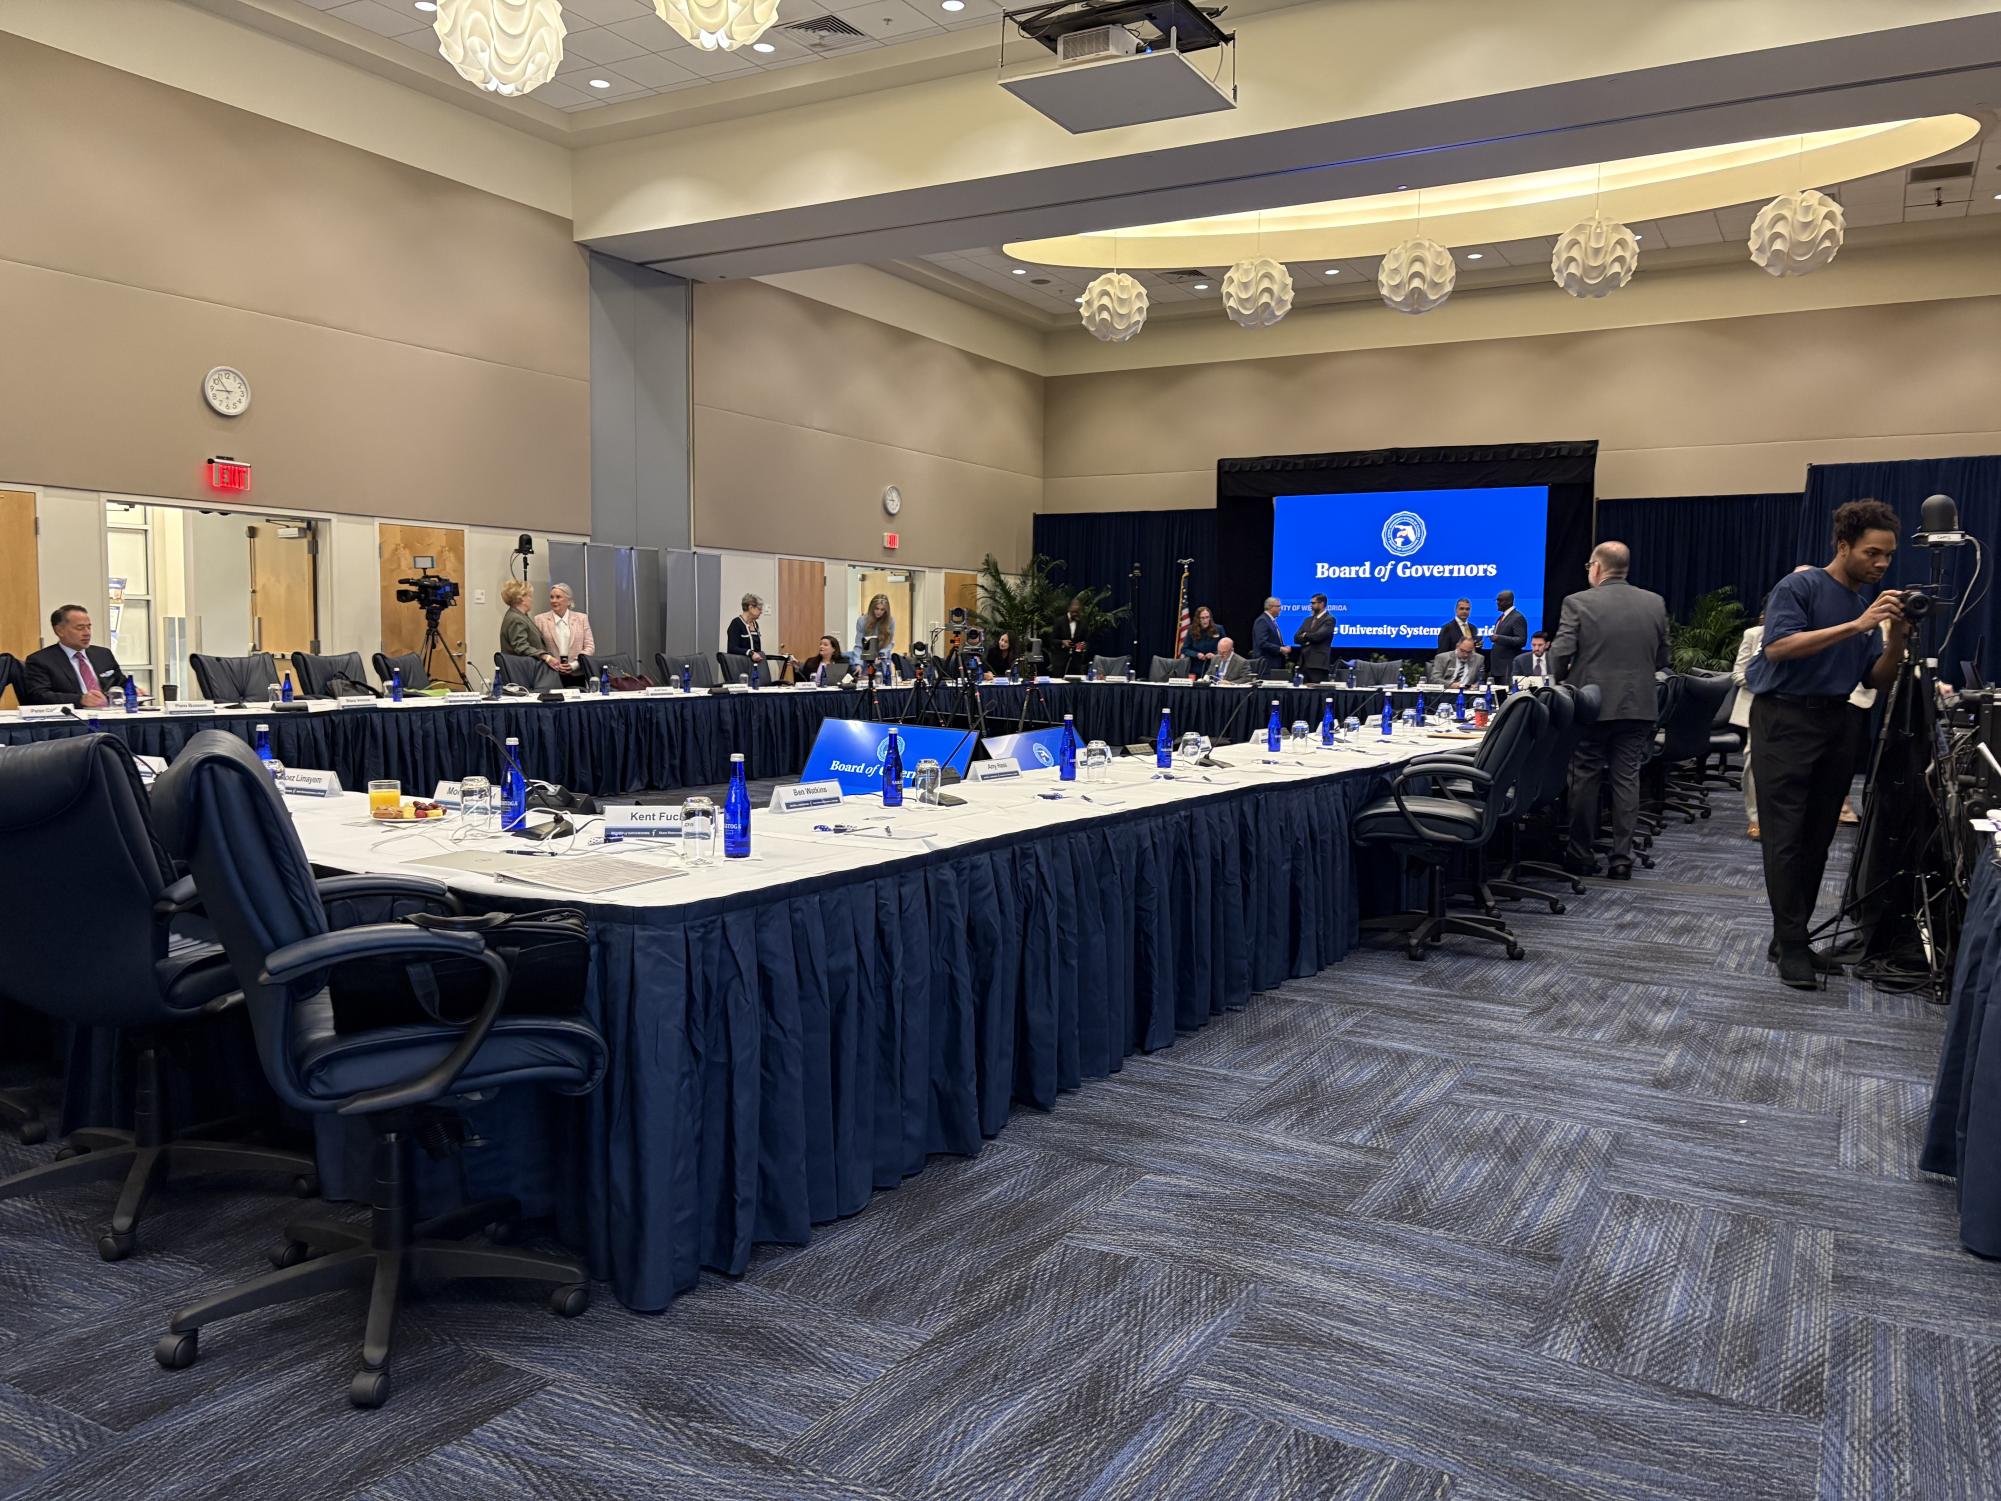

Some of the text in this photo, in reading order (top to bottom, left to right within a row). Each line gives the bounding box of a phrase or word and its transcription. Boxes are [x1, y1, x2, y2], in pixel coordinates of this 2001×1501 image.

[1316, 561, 1498, 583] Board of Governors
[1340, 624, 1399, 638] University
[1399, 624, 1441, 638] System
[830, 760, 866, 774] Board
[865, 764, 880, 777] of
[792, 786, 828, 797] Ben Watkins
[630, 812, 682, 821] Kent Fuc
